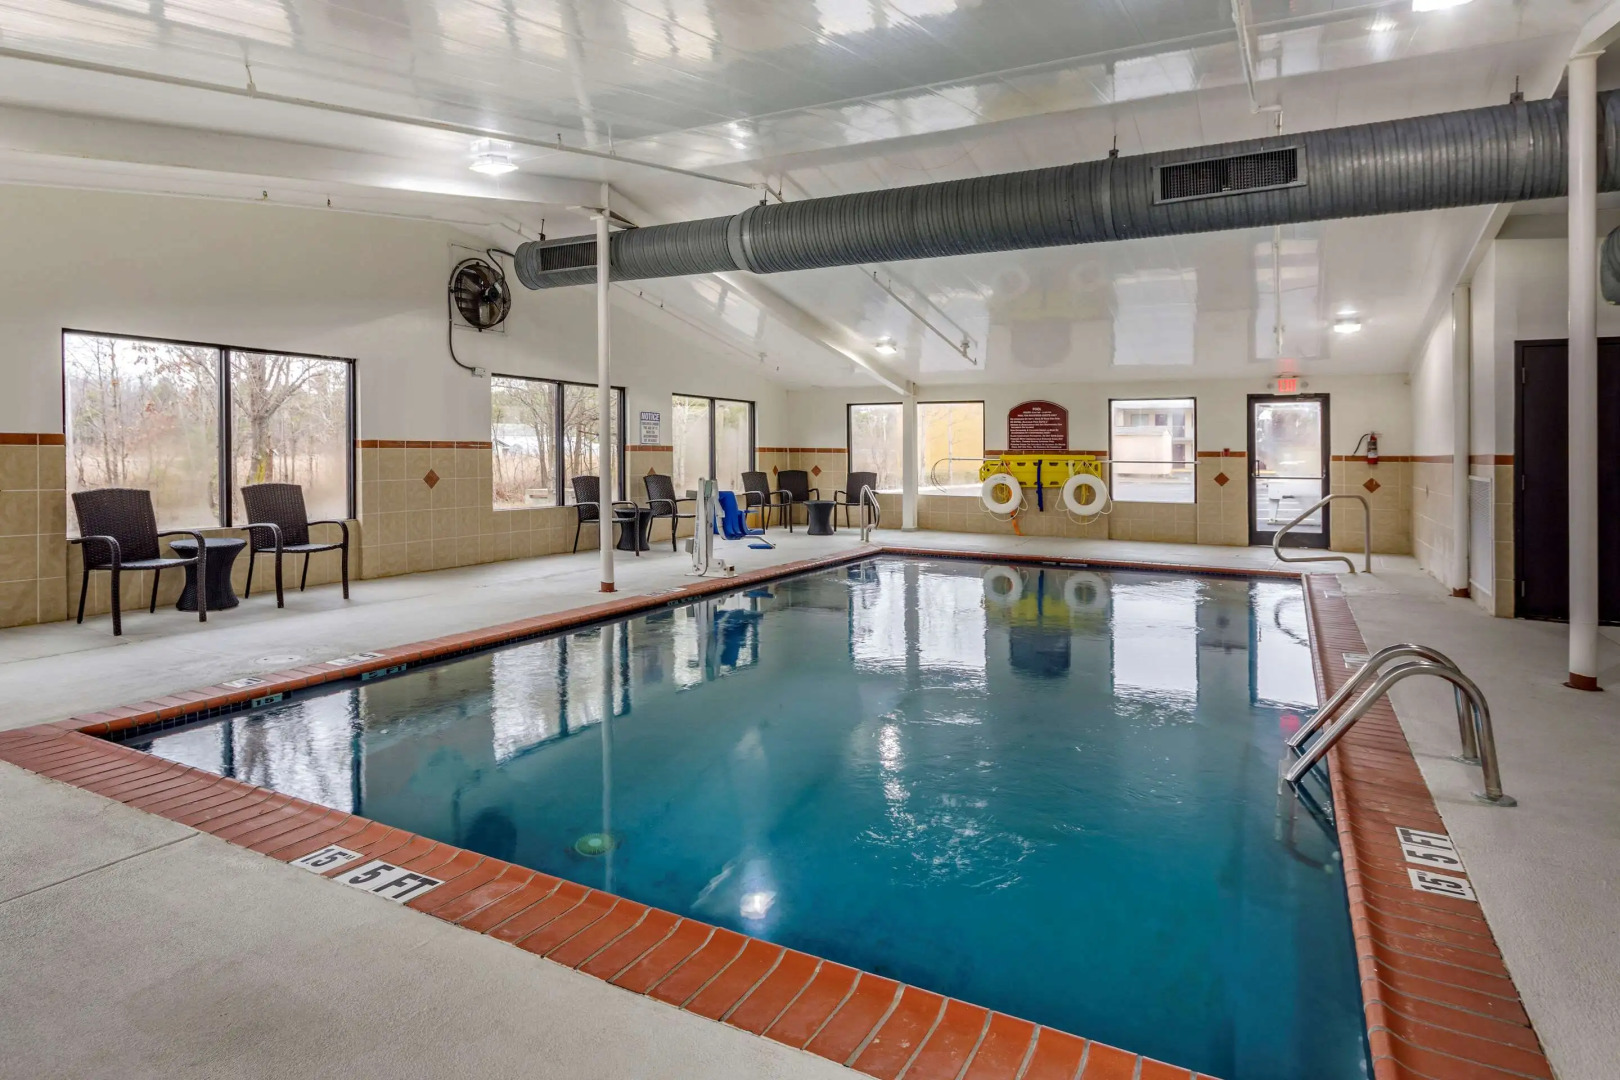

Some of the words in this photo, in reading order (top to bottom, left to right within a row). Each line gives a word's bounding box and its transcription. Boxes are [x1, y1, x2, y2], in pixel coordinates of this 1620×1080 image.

[1278, 379, 1296, 392] EXIT
[641, 411, 660, 421] NOTICE
[1399, 828, 1453, 850] FT
[1406, 850, 1458, 864] 5
[349, 864, 396, 884] 5
[373, 873, 440, 899] FT
